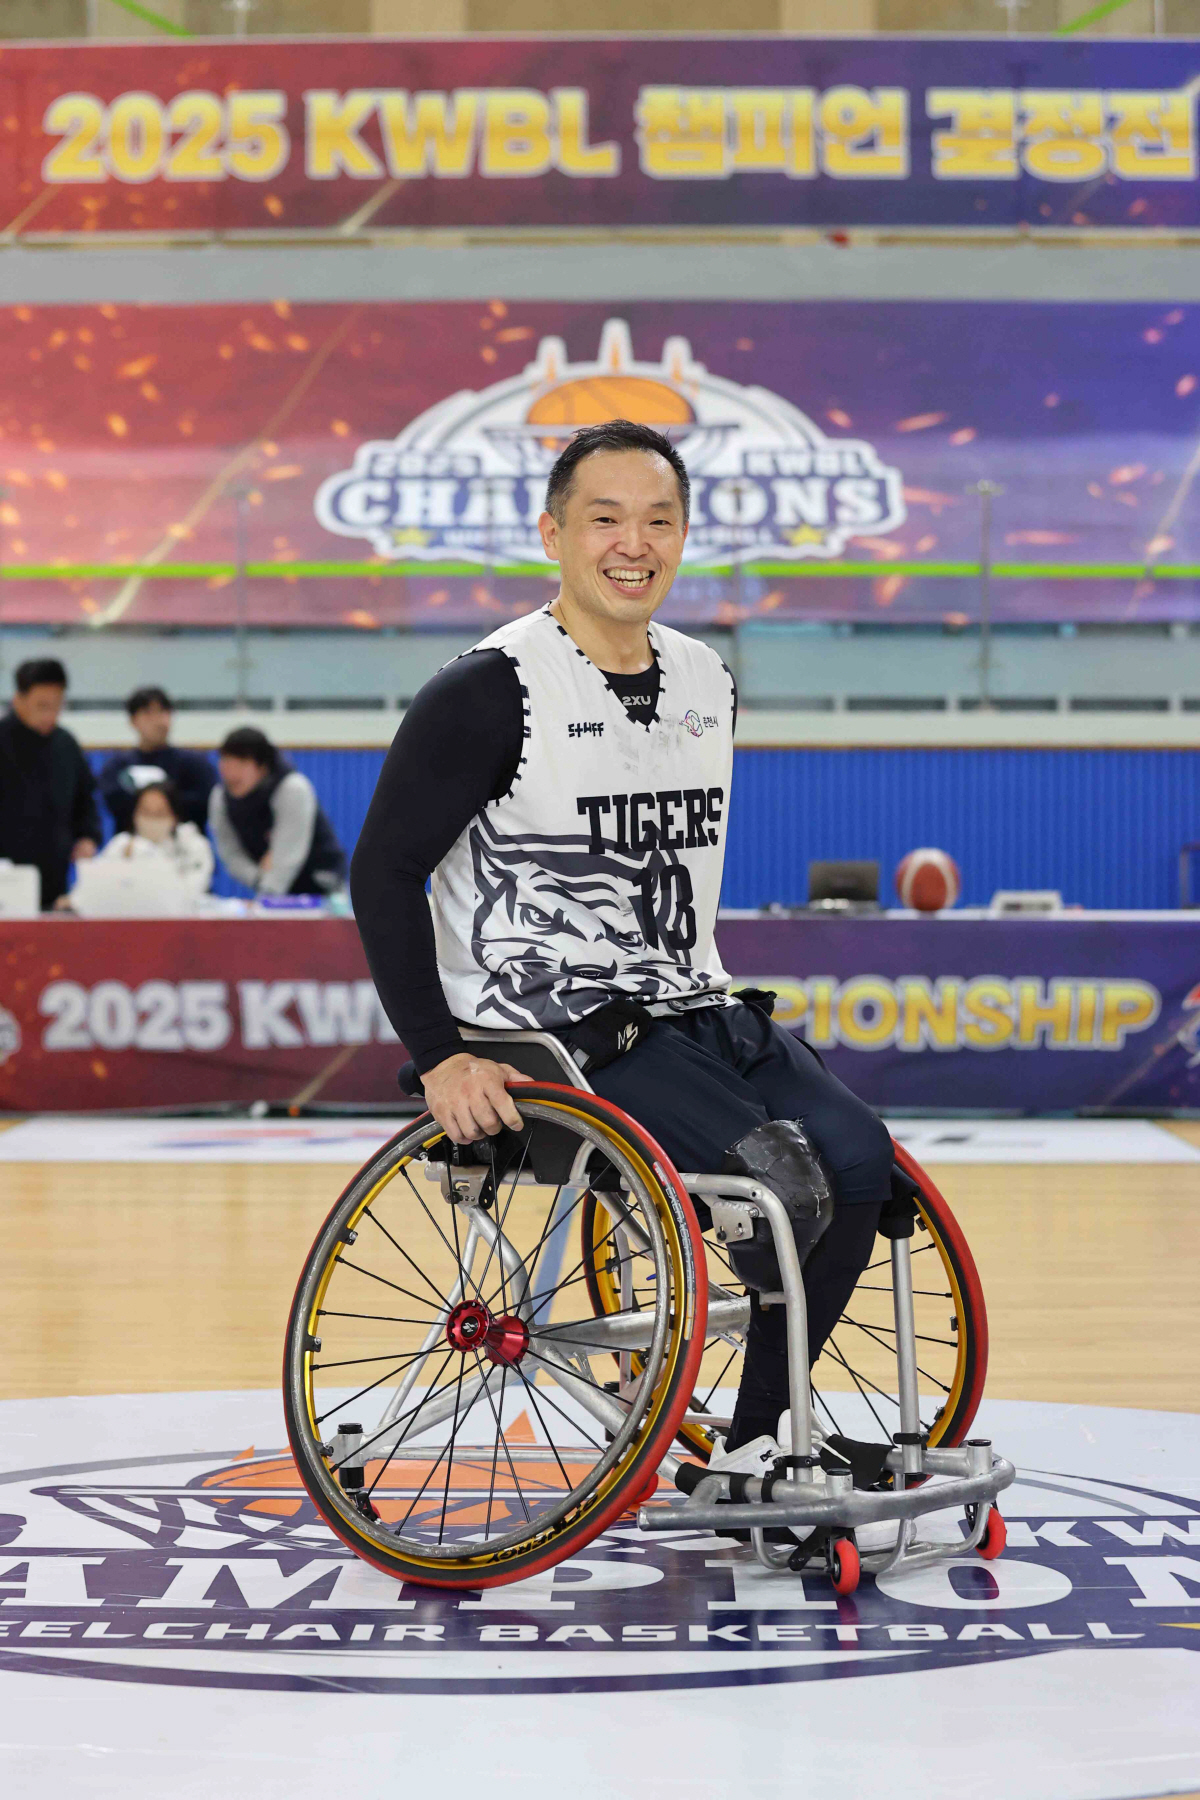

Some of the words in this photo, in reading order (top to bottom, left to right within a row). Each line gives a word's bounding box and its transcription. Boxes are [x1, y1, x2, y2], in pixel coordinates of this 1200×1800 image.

[42, 91, 290, 183] 2025
[305, 87, 621, 179] KWBL
[634, 85, 909, 180] 챔피언
[926, 87, 1197, 182] 결정전
[621, 695, 652, 706] 2XU
[576, 787, 723, 855] TIGERS
[631, 863, 697, 951] 13
[39, 980, 233, 1051] 2025
[479, 1622, 1146, 1643] BASKETBALL
